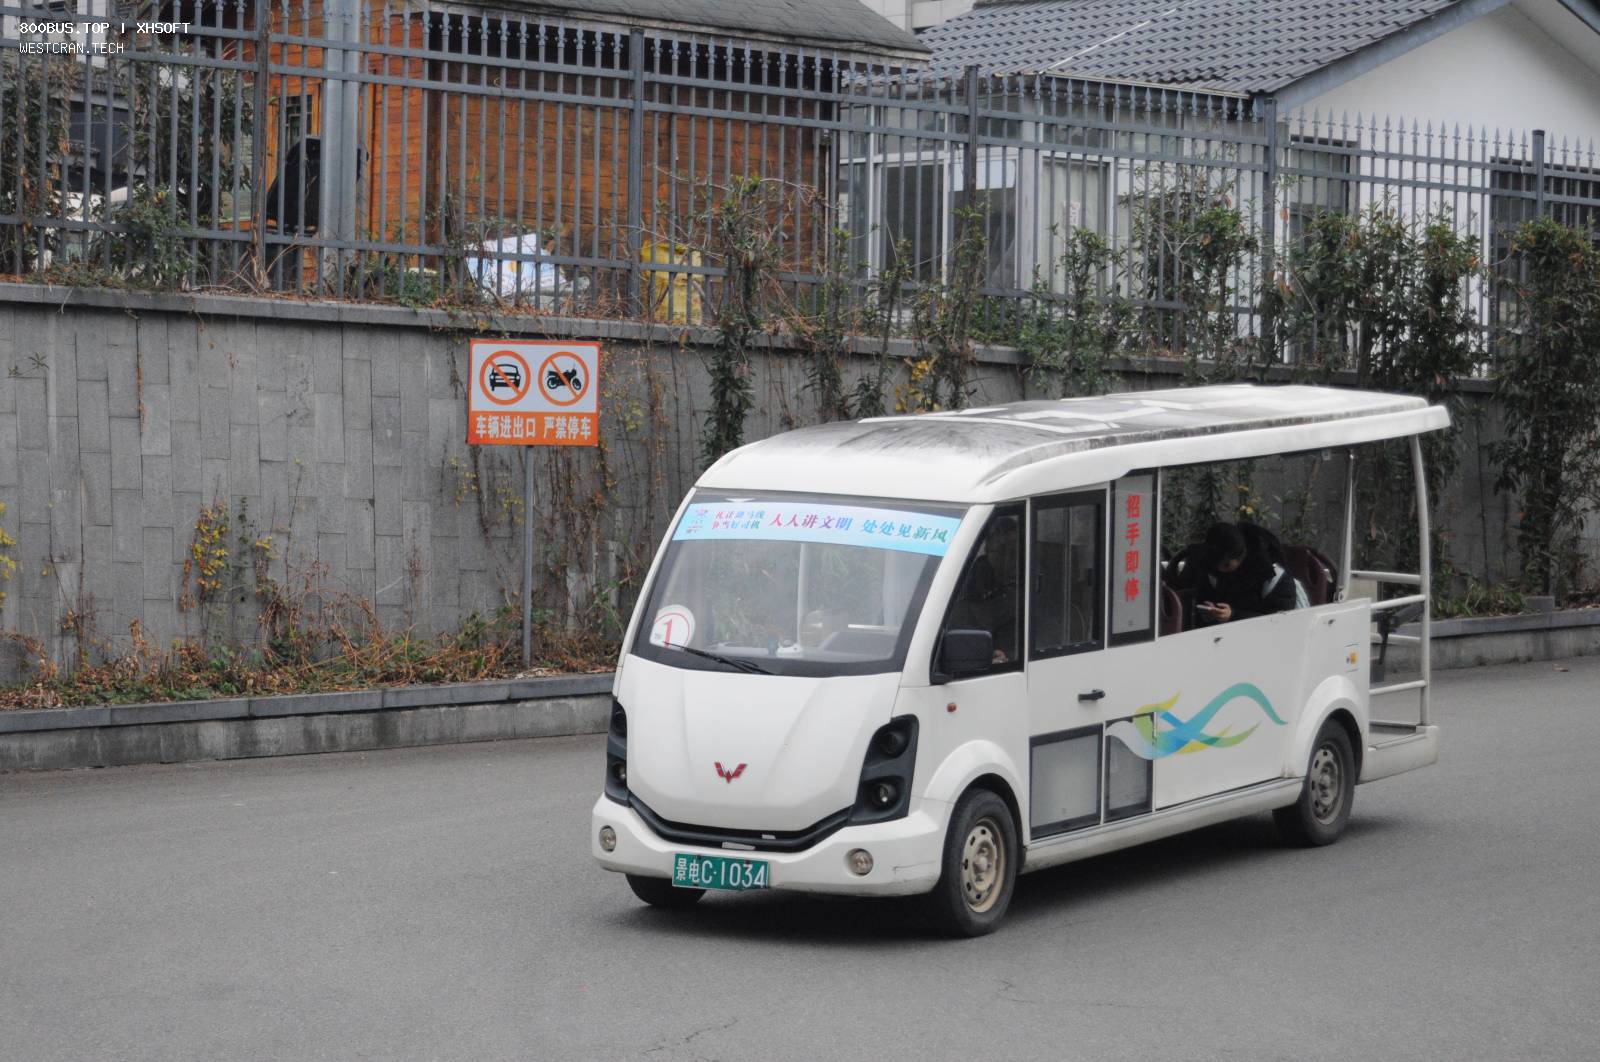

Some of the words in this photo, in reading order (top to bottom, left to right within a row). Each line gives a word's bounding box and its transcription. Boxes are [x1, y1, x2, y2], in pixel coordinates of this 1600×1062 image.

[475, 415, 536, 438] 车辆进出口
[543, 416, 591, 440] 严禁停车
[768, 513, 854, 532] 人人讲文明
[861, 518, 949, 544] 处处见新风
[1124, 494, 1140, 602] 招手即停
[662, 618, 673, 648] 1
